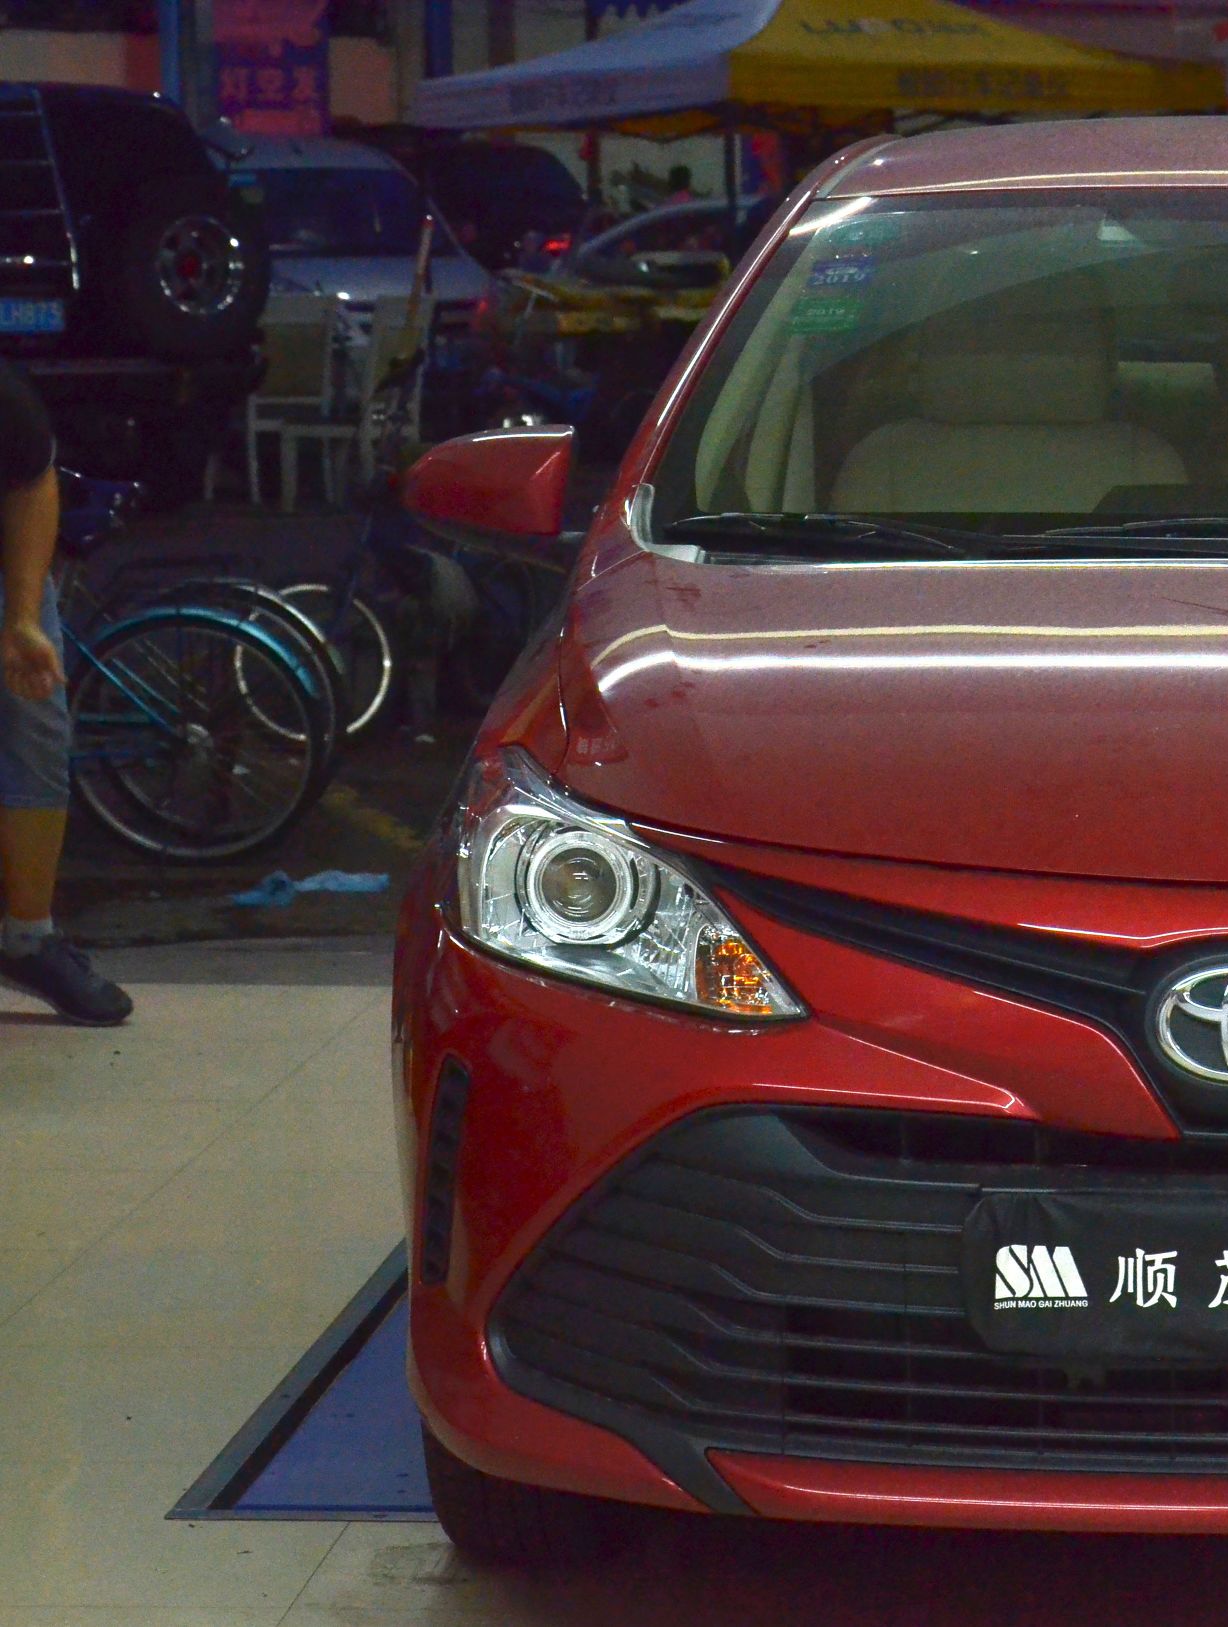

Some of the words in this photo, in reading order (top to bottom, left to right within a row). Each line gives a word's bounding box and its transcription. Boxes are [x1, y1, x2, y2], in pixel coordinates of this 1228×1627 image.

[994, 1244, 1088, 1300] SM
[994, 1300, 1017, 1310] SHUN
[1017, 1300, 1037, 1309] MAO
[1038, 1300, 1053, 1309] GAI
[1054, 1299, 1089, 1309] ZHUANG
